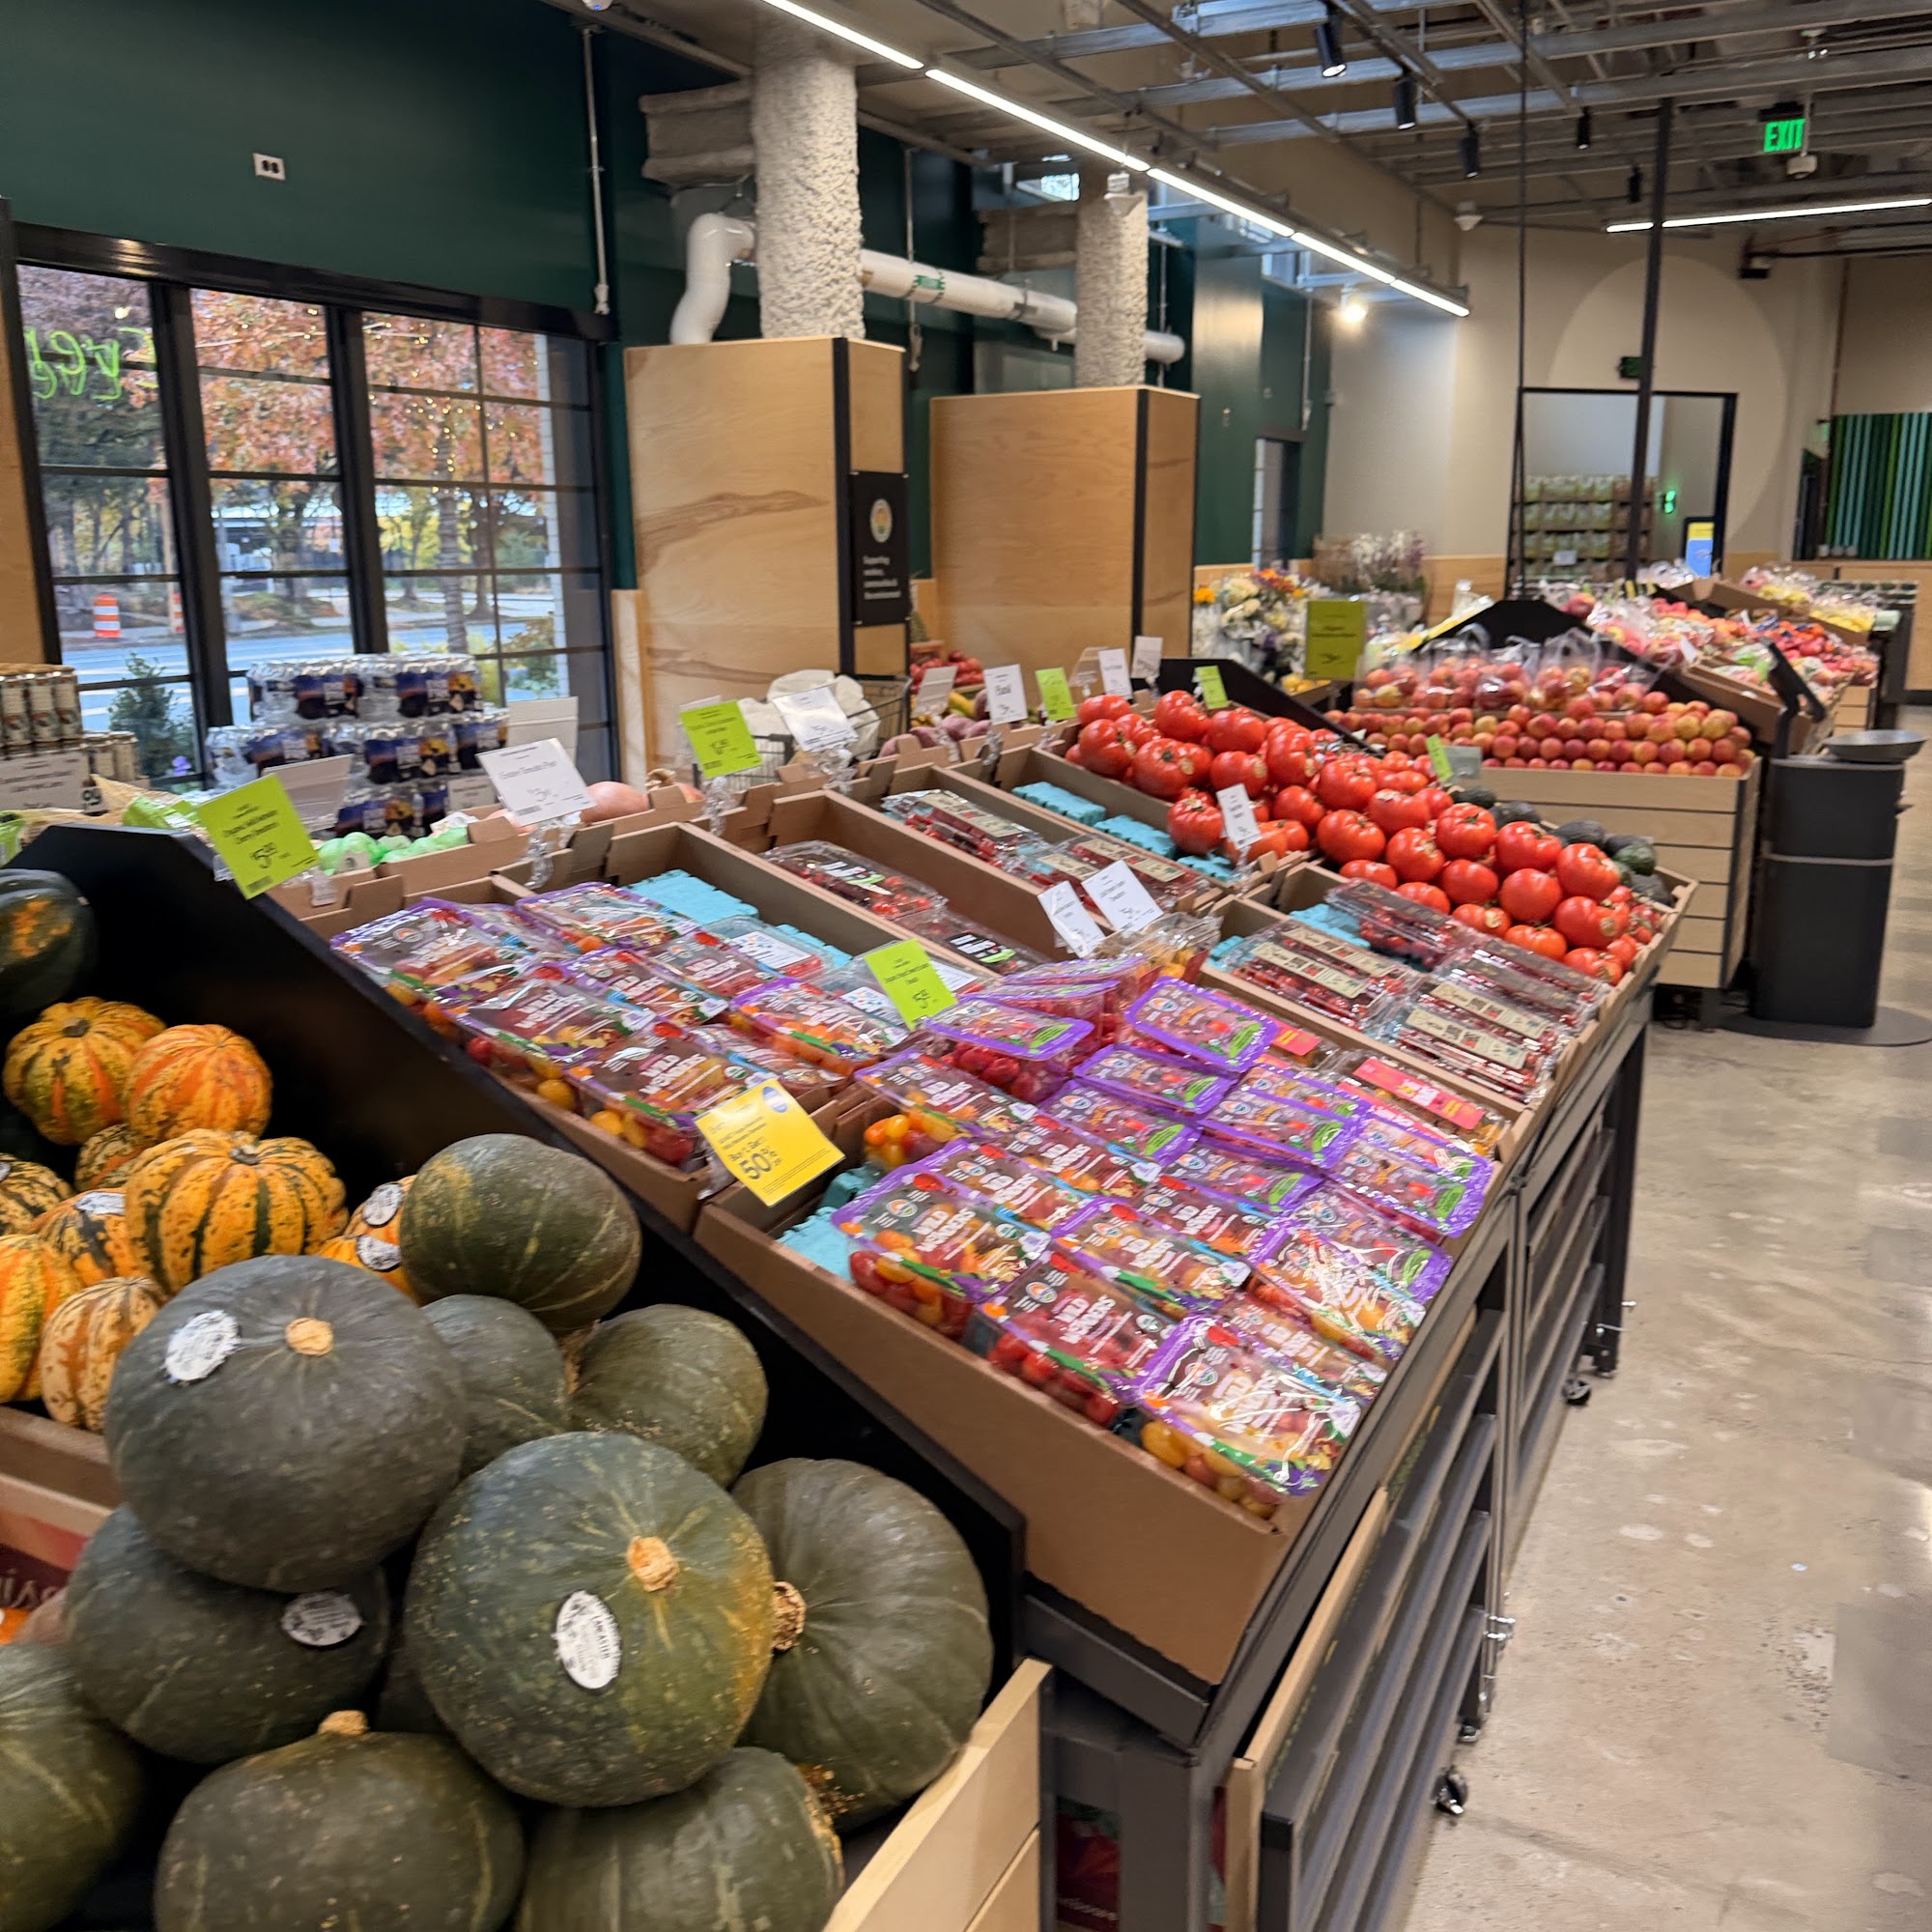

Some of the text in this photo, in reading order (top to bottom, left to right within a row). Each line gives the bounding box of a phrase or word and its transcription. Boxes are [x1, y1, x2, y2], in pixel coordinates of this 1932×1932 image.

[1764, 118, 1805, 153] EXIT
[912, 1209, 950, 1236] WILD
[915, 1207, 977, 1253] WONDERS
[1054, 1297, 1091, 1323] WILD
[1059, 1293, 1117, 1345] WONDERS
